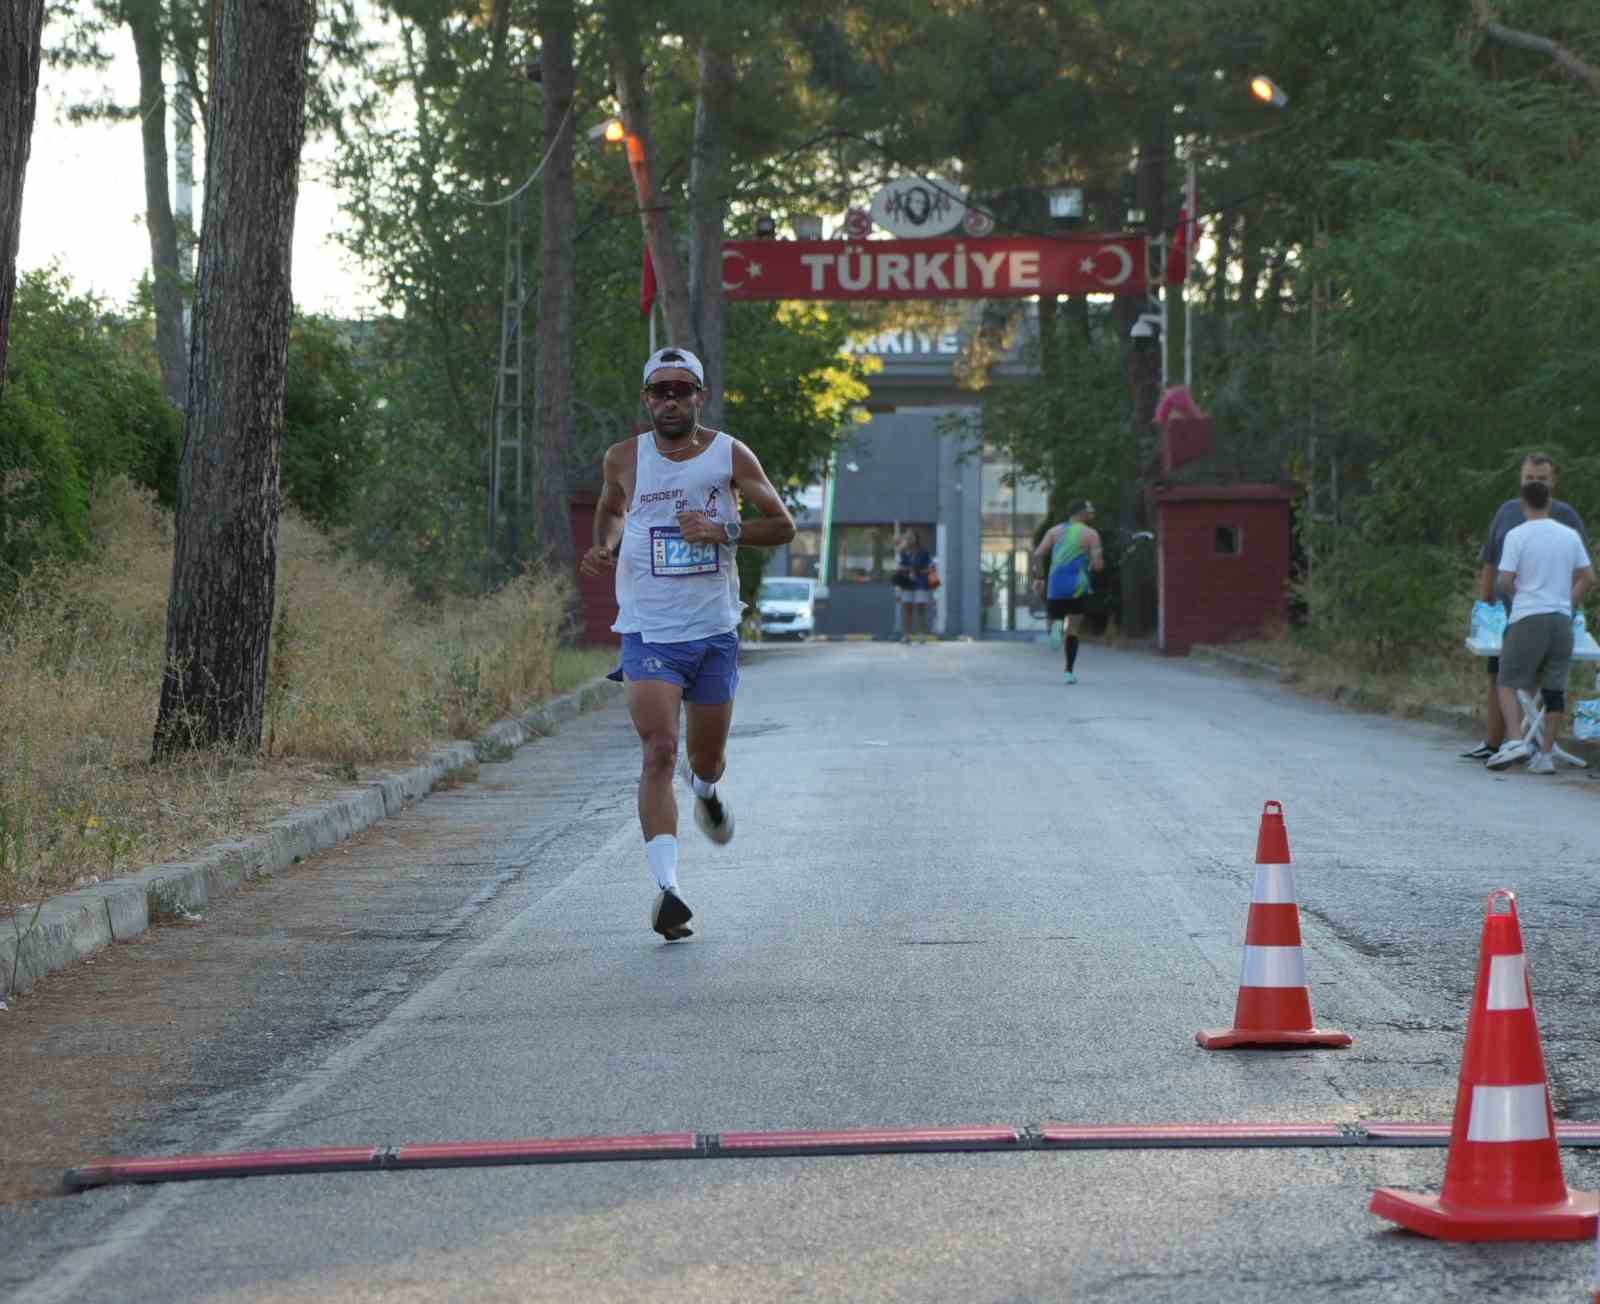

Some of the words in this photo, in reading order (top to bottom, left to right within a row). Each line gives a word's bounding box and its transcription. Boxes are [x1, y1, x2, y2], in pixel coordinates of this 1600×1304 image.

[801, 244, 1041, 291] TÜRKİYE
[640, 488, 683, 504] ACADEMY
[675, 499, 689, 510] OF
[670, 541, 715, 562] 2254
